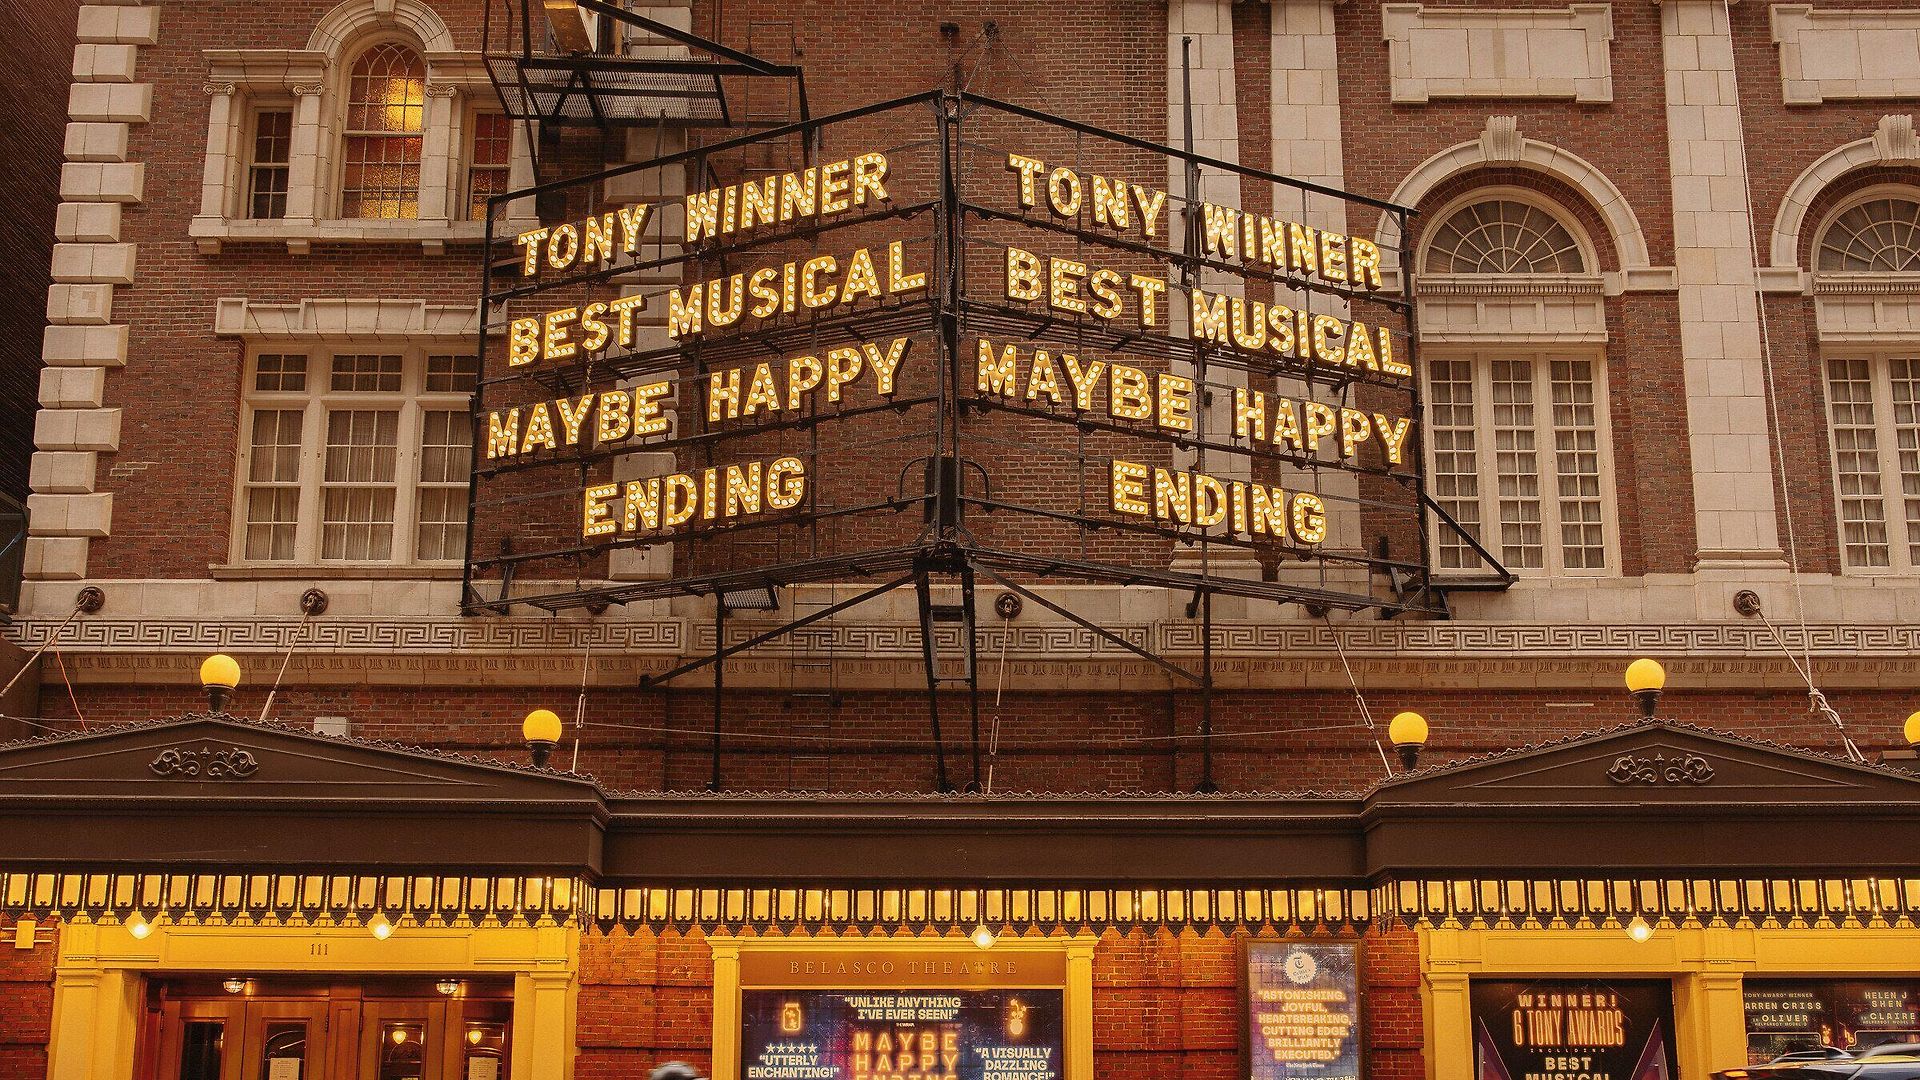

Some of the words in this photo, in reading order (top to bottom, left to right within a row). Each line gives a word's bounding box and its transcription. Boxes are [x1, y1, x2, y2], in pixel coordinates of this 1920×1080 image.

[518, 204, 651, 276] TONY
[687, 152, 889, 242] WINNER
[1006, 153, 1166, 238] TONY
[1201, 202, 1383, 290] WINNER
[509, 294, 643, 367] BEST
[668, 240, 926, 340] MUSICAL
[1005, 247, 1165, 329] BEST
[1189, 288, 1411, 377] MUSICAL
[487, 381, 671, 460] MAYBE
[709, 337, 910, 422] HAPPY
[976, 337, 1193, 433] MAYBE
[1233, 387, 1411, 465] HAPPY
[584, 457, 804, 537] ENDING
[1110, 459, 1327, 544] ENDING
[311, 944, 328, 955] 111
[789, 961, 894, 974] BELASCO
[908, 961, 1017, 974] THEATRE
[845, 997, 893, 1008] “UNLIKE
[897, 997, 961, 1008] ANYTHING
[1518, 995, 1616, 1007] WINNER!
[886, 1009, 914, 1020] EVER
[1282, 1003, 1328, 1013] JOYFUL,
[1258, 1015, 1352, 1025] HEARTBREAKING,
[1262, 1027, 1314, 1036] CUTTING
[1513, 1010, 1523, 1045] 6
[1527, 1011, 1561, 1045] TONY
[1568, 1010, 1624, 1045] AWARDS
[856, 1034, 957, 1050] MAYBE
[1268, 1039, 1341, 1048] BRILLIANTLY
[992, 1048, 1051, 1058] VISUALLY
[760, 1055, 818, 1066] “UTTERLY
[856, 1055, 957, 1071] HAPPY
[985, 1060, 1047, 1071] DAZZLING
[1545, 1057, 1591, 1070] BEST
[748, 1067, 840, 1078] ENCHANTING!”
